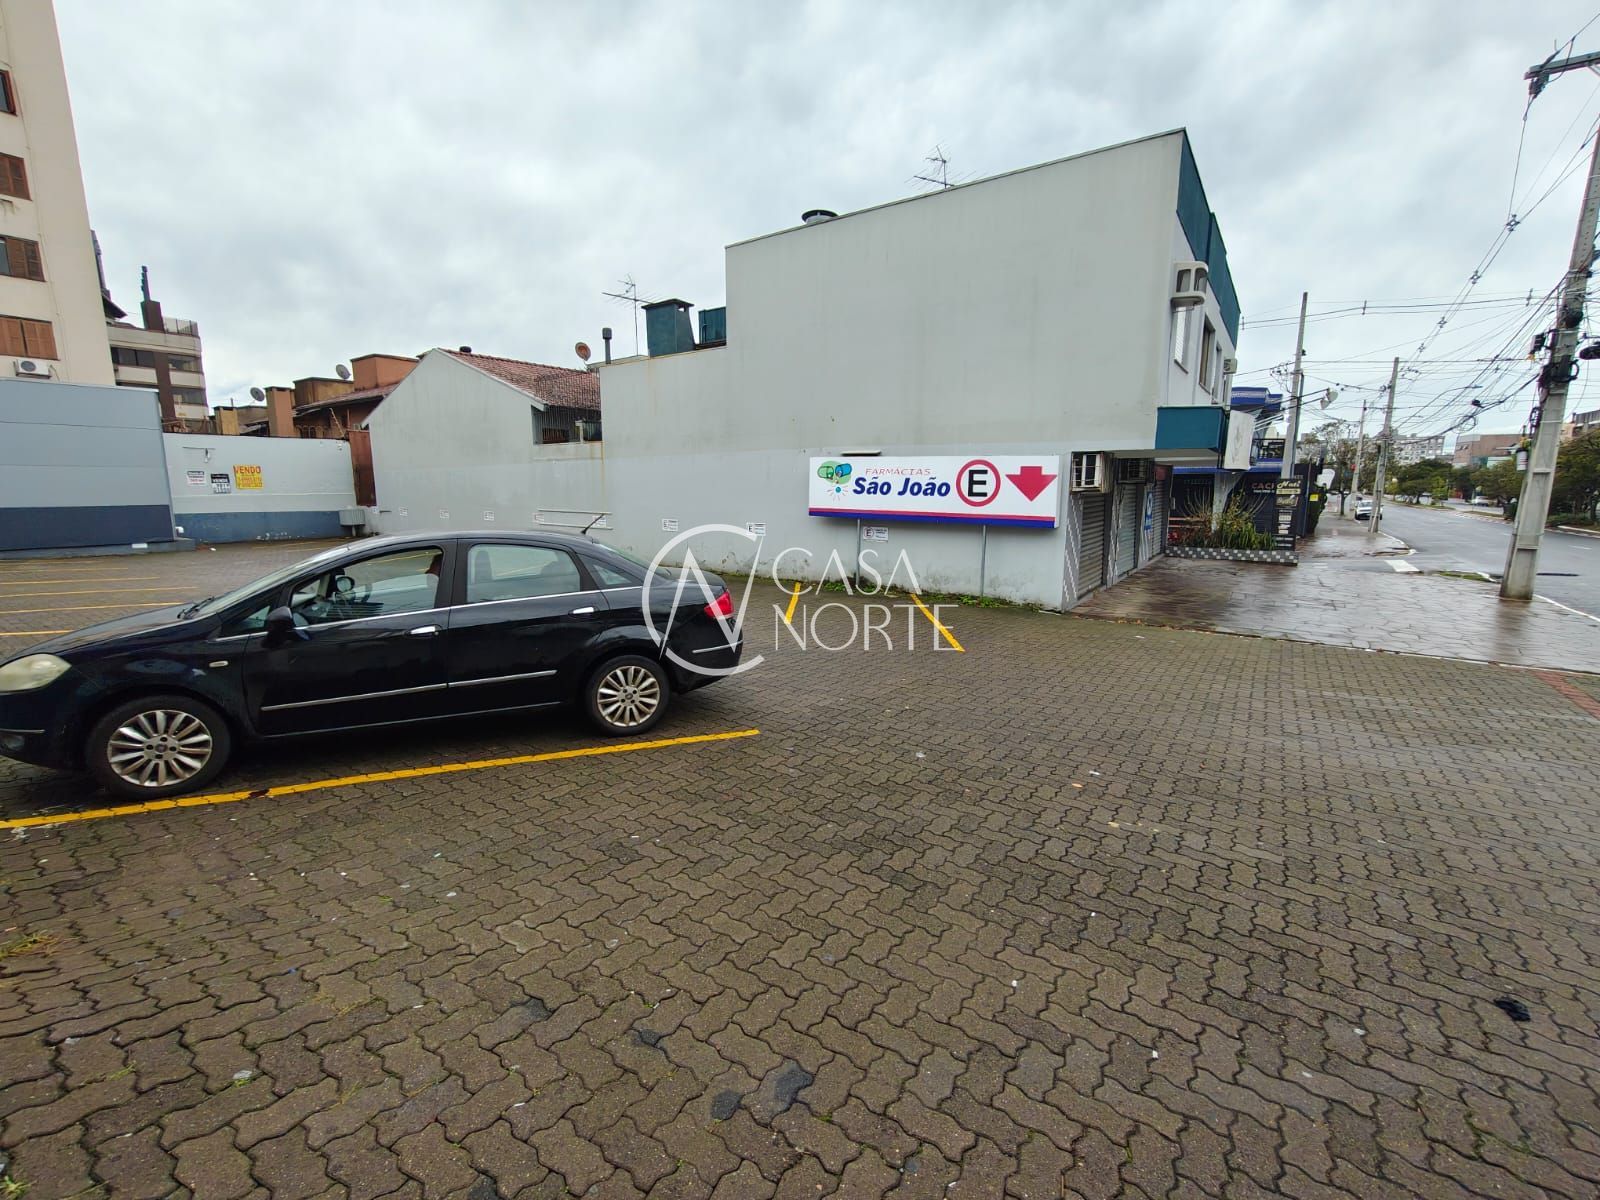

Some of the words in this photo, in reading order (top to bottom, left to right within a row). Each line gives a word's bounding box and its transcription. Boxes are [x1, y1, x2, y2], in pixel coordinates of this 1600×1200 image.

[233, 465, 262, 474] VENDO
[852, 476, 892, 496] São
[897, 476, 951, 497] João
[967, 469, 988, 498] E
